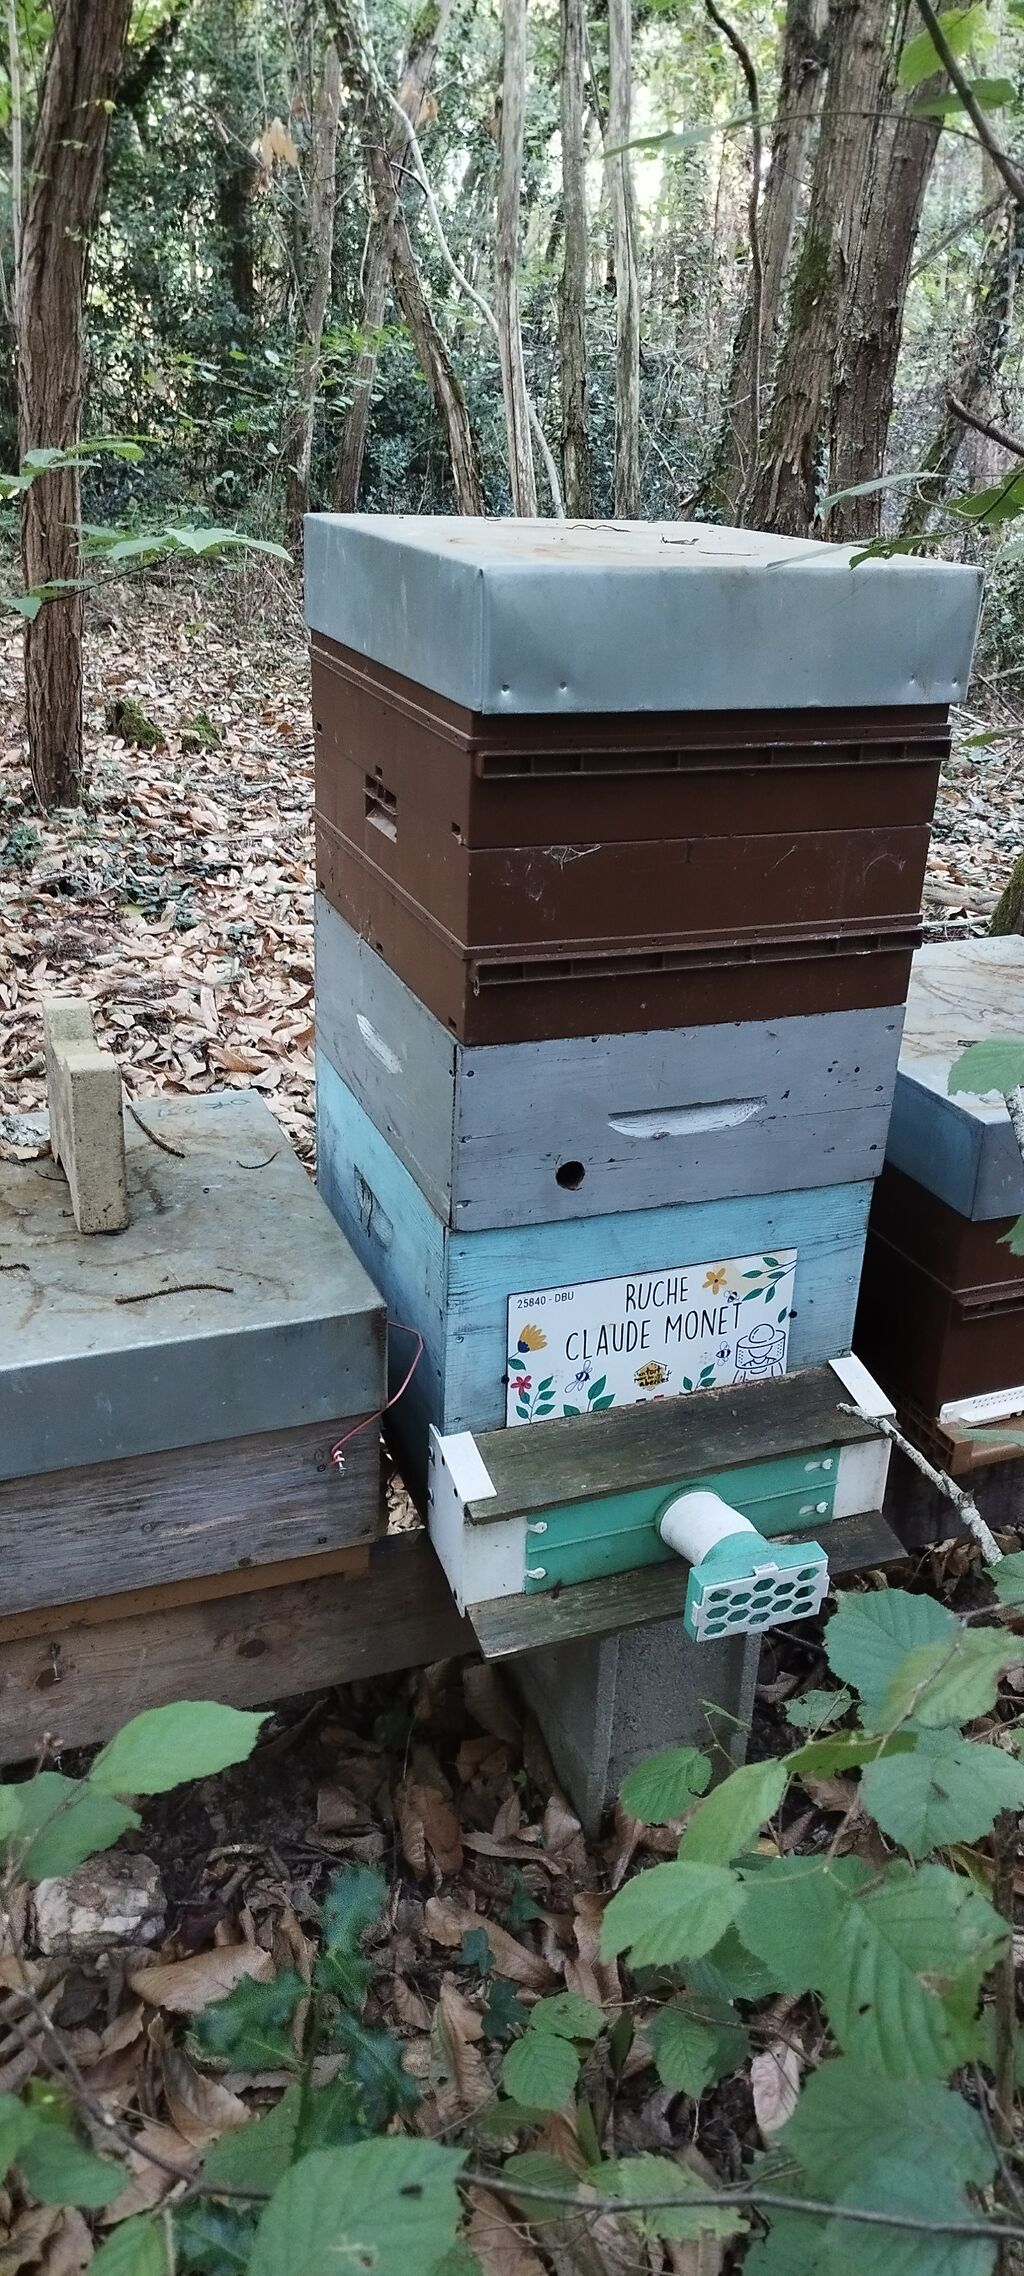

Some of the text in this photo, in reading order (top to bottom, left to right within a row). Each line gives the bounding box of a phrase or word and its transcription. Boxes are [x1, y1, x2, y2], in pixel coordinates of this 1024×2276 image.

[517, 1296, 546, 1309] 25840
[554, 1291, 574, 1303] DBU
[625, 1276, 689, 1313] RUCHE
[566, 1302, 742, 1361] CLAUDE MONET
